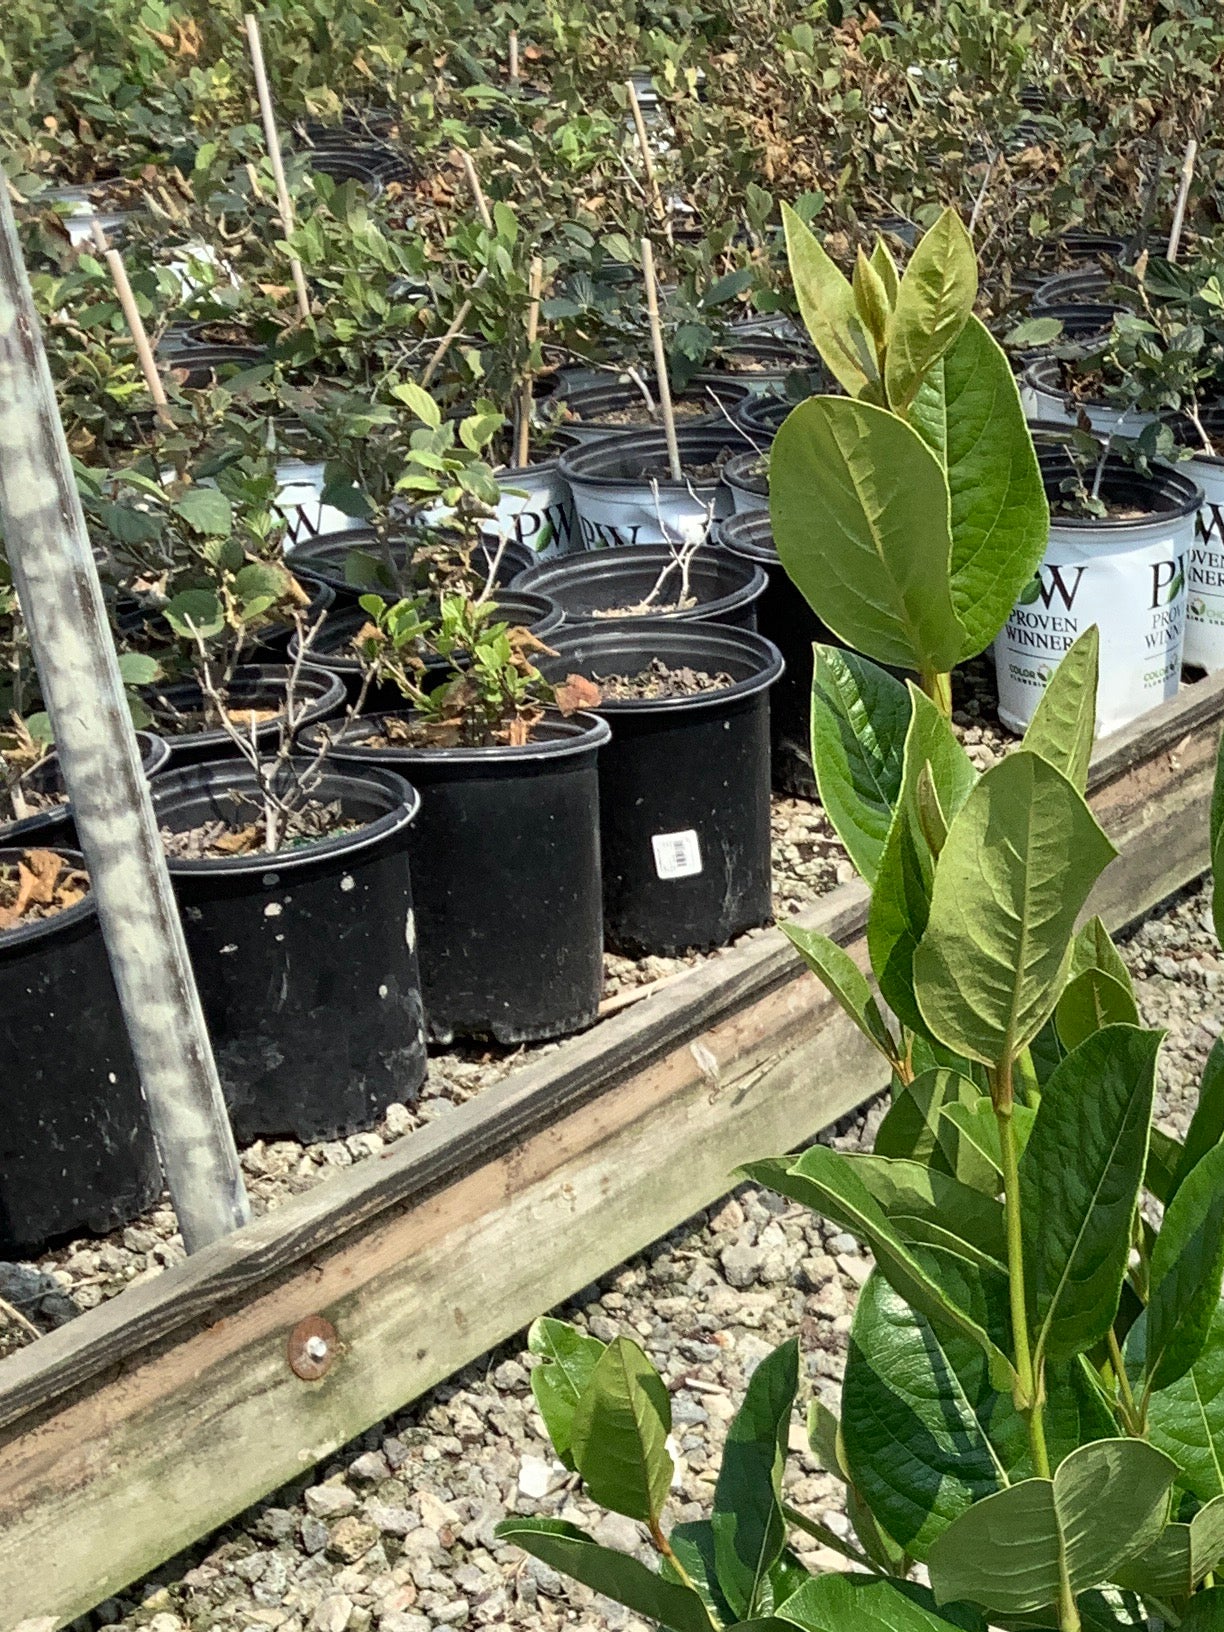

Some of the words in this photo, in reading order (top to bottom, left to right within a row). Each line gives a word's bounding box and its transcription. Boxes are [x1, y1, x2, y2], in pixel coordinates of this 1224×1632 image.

[1034, 563, 1089, 613] W
[1009, 608, 1078, 633] PROVEN
[1004, 624, 1074, 652] WINNER
